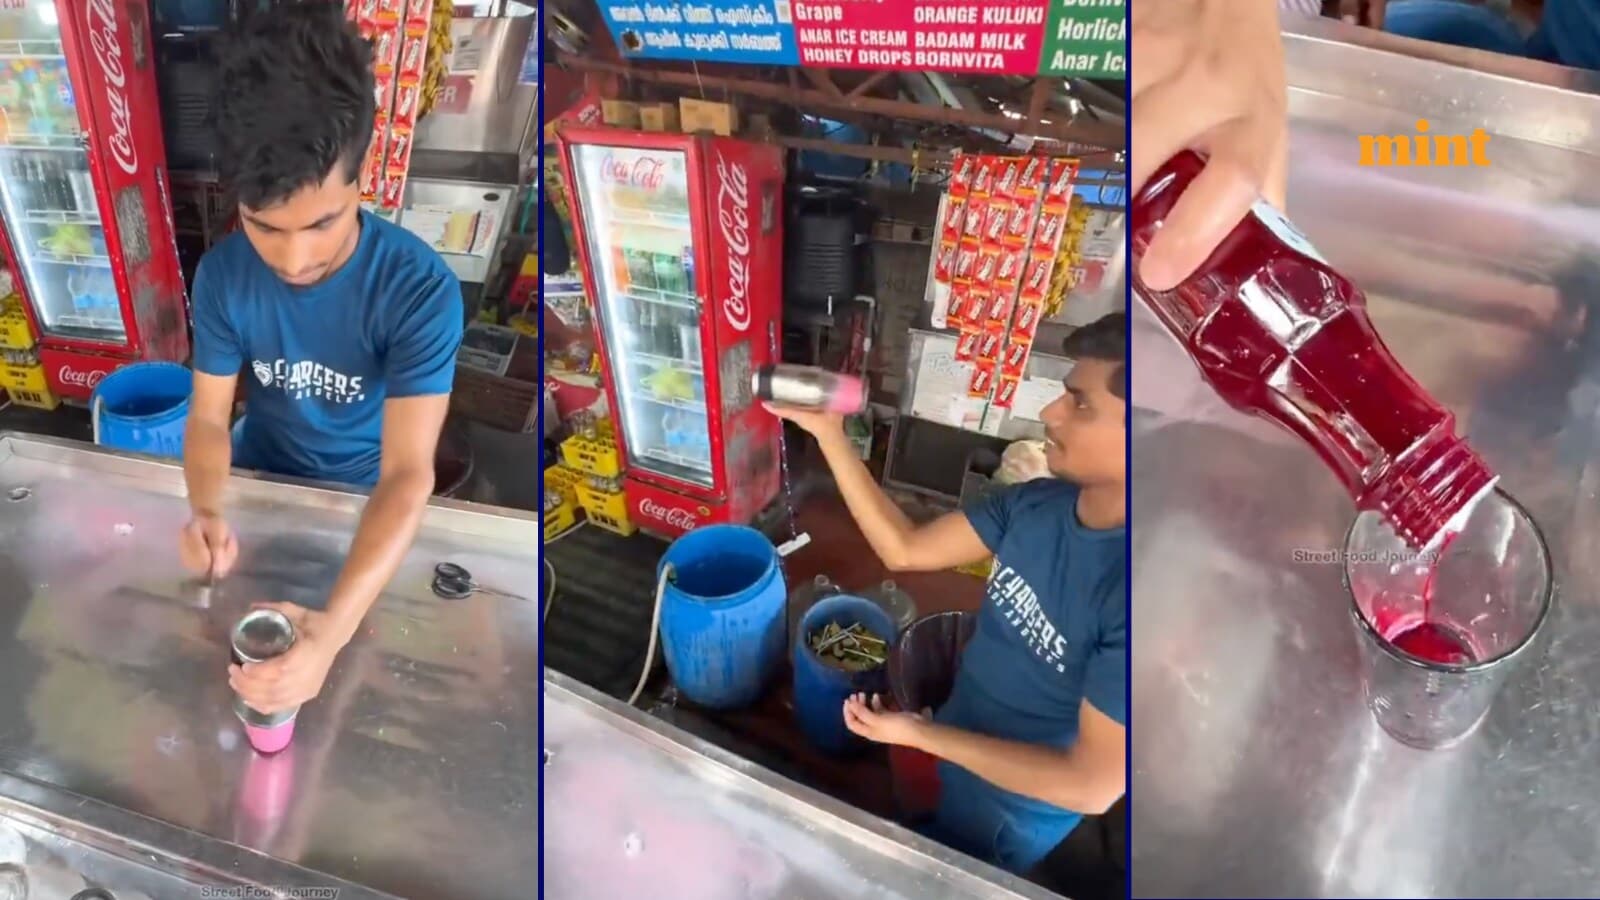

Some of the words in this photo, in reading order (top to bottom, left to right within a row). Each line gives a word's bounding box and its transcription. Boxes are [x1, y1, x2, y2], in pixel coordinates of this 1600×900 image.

[795, 3, 843, 23] Grape
[914, 6, 978, 24] ORANGE
[983, 6, 1044, 25] KULUKI
[800, 27, 833, 44] ANAR
[835, 29, 858, 45] ICE
[860, 29, 908, 46] CREAM
[915, 32, 975, 49] BADAM
[981, 33, 1026, 51] MILK
[803, 48, 854, 63] HONEY
[858, 49, 912, 66] DROPS
[915, 51, 1005, 69] BORNVITA
[1050, 49, 1099, 71] Anar
[1102, 50, 1126, 72] Ic
[716, 150, 751, 332] Coca-Cola
[58, 364, 108, 389] Coca-C
[996, 566, 1067, 659] CHARGERS
